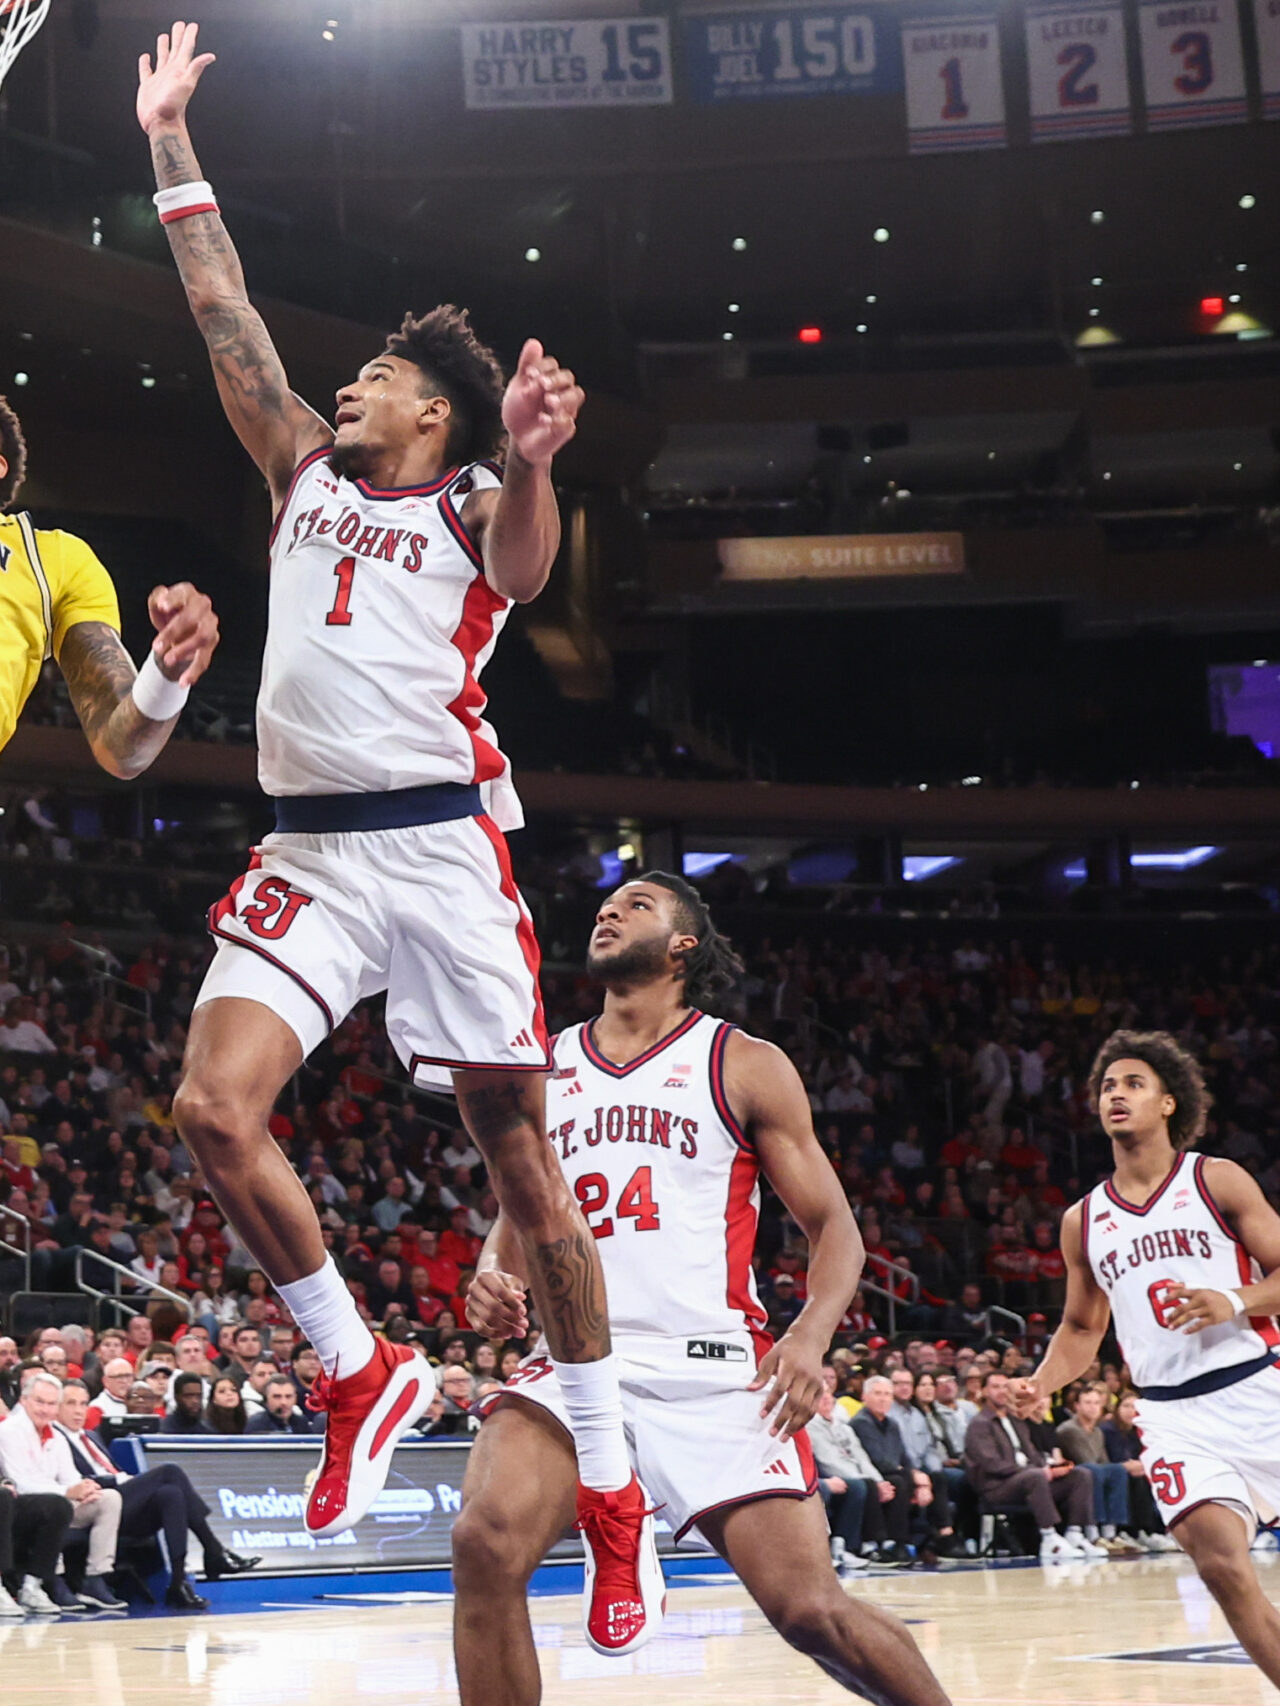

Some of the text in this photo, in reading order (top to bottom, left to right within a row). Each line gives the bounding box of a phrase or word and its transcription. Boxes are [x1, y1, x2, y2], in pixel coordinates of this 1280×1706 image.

[475, 56, 587, 85] STYLES
[478, 27, 574, 54] HARRY
[601, 24, 662, 82] 15
[773, 15, 876, 79] 150
[1170, 31, 1214, 95] 3
[938, 57, 969, 121] 1
[1056, 43, 1099, 107] 2
[316, 506, 429, 573] JOHN'S
[809, 548, 875, 568] SUITE
[884, 544, 953, 566] LEVEL
[325, 556, 357, 626] 1
[239, 876, 314, 940] SJ
[548, 1105, 699, 1160] T. JOHN'S
[574, 1165, 660, 1240] 24
[1099, 1228, 1212, 1291] ST. JOHN'S
